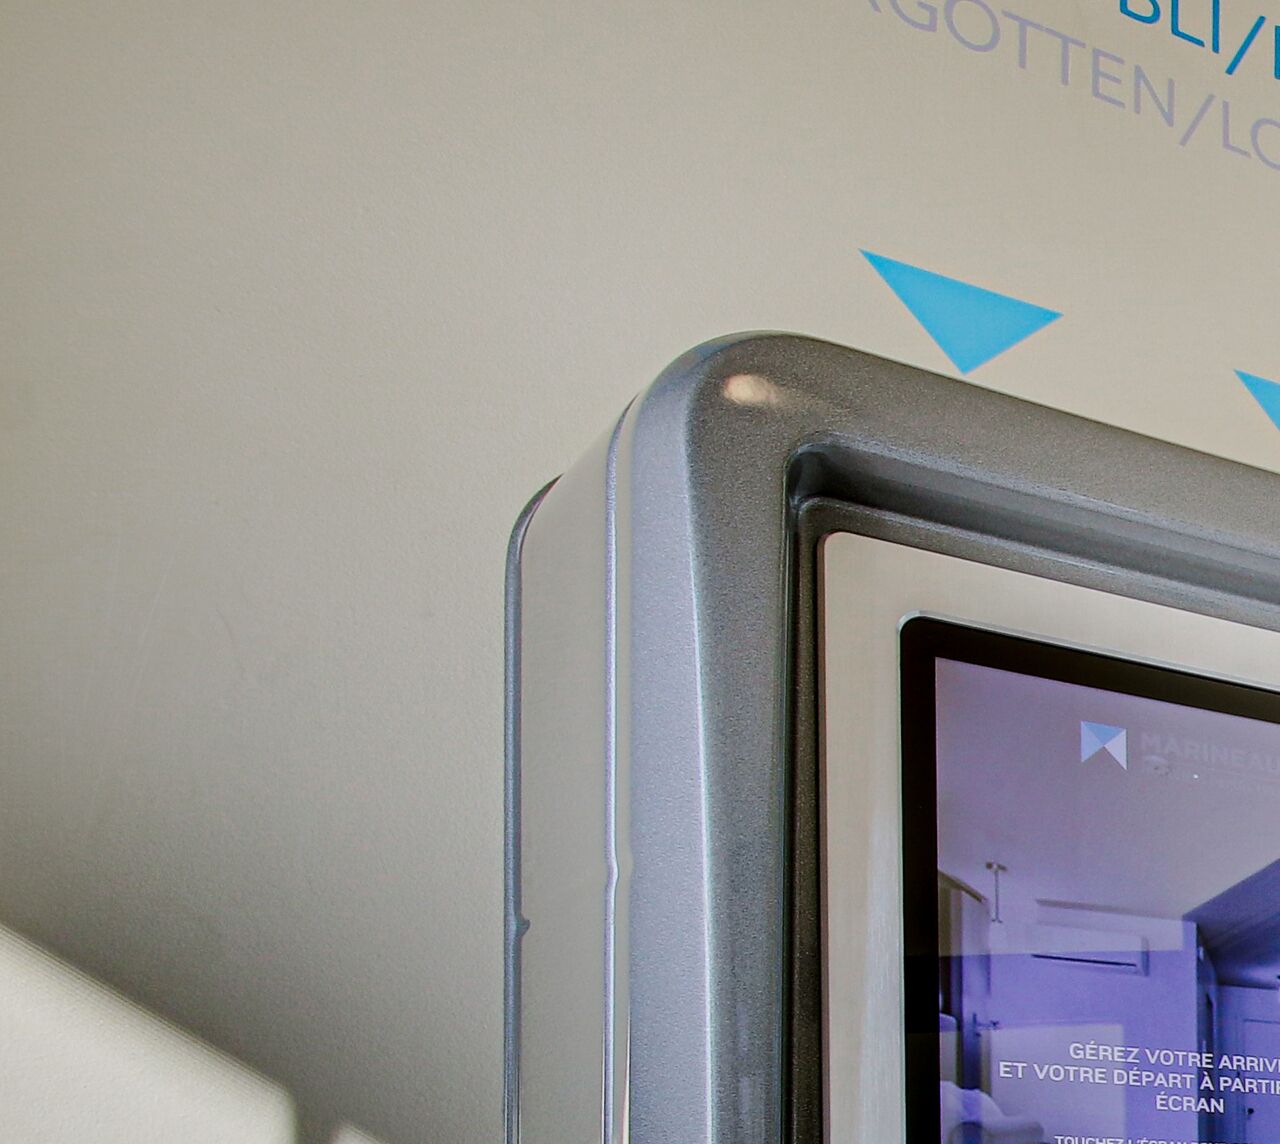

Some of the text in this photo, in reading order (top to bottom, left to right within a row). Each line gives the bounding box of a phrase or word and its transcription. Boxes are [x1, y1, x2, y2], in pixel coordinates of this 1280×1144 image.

[1069, 1040, 1140, 1065] GÉREZ
[1145, 1047, 1214, 1070] VOTRE
[999, 1061, 1025, 1081] ET
[1033, 1064, 1107, 1085] VOTRE
[1113, 1064, 1195, 1090] DÉPART
[1199, 1068, 1214, 1092] À
[1156, 1091, 1225, 1115] ÉCRAN
